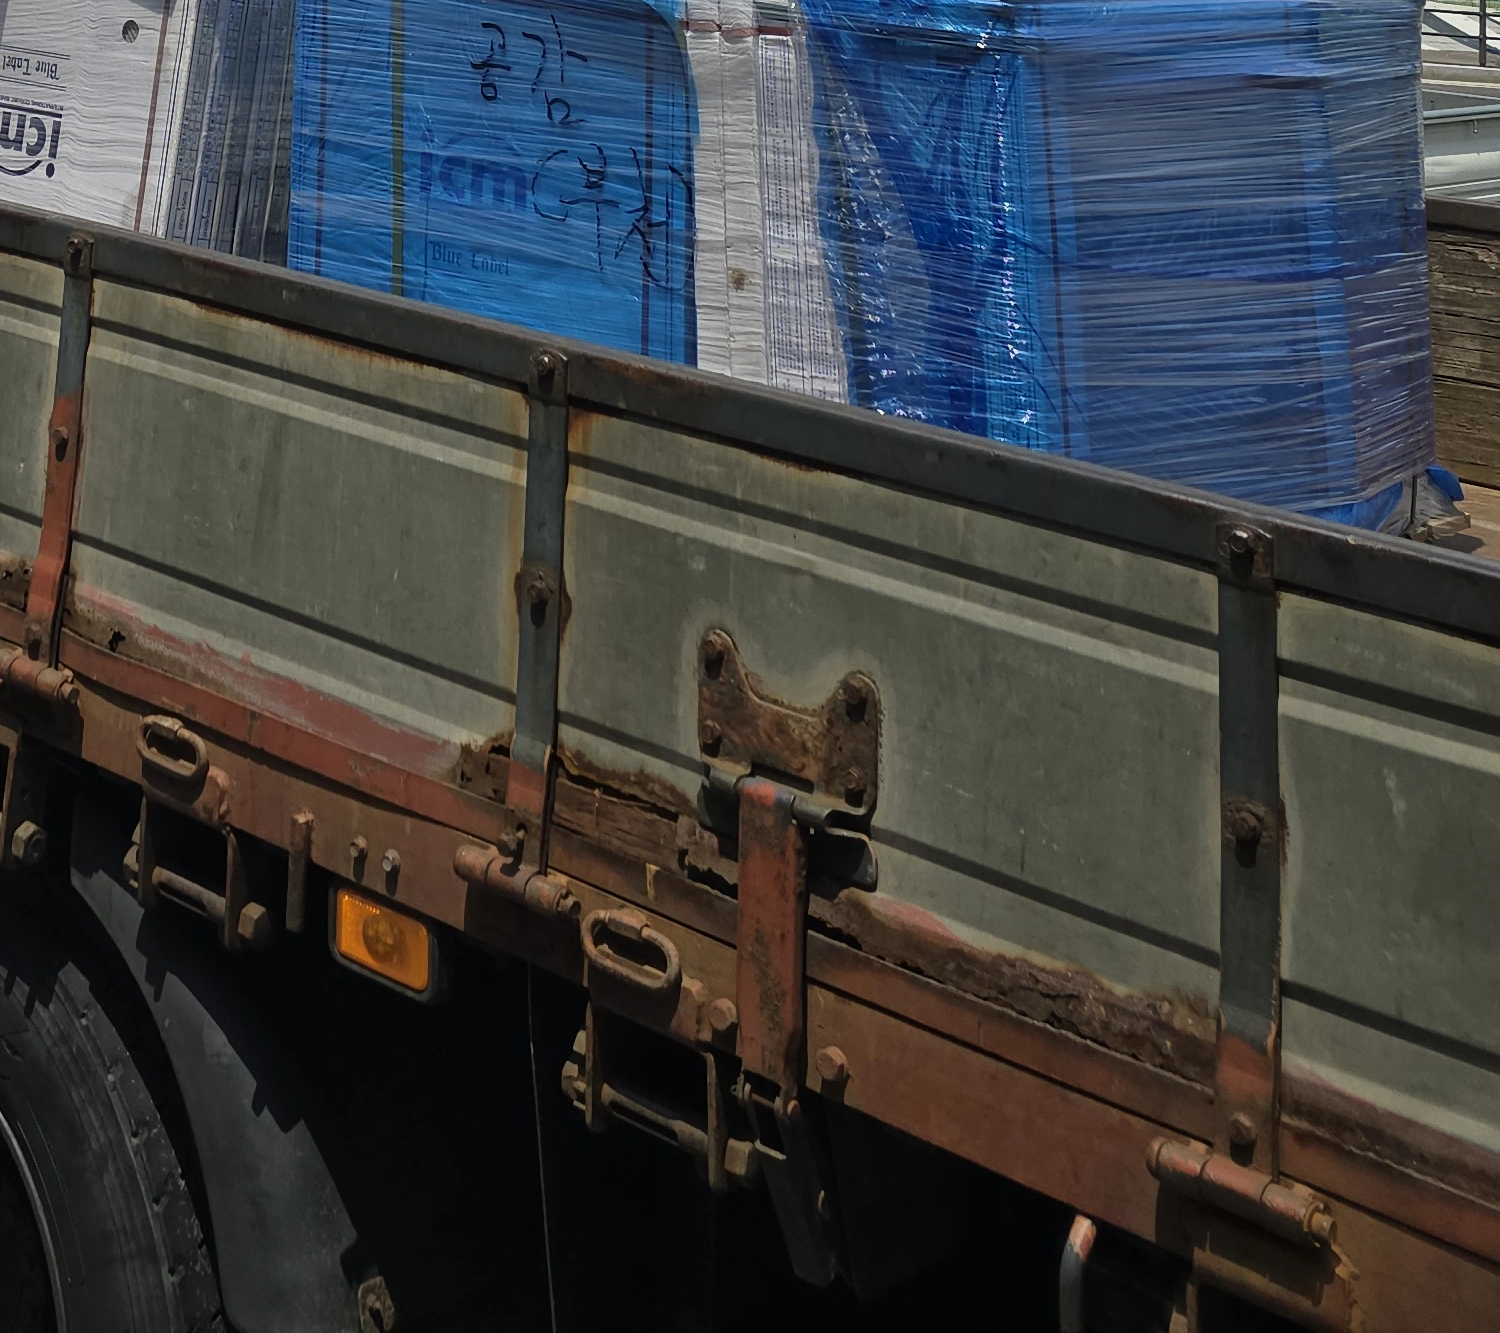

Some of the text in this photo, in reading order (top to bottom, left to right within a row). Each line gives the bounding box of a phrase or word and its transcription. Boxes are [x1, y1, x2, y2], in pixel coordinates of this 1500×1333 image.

[2, 54, 60, 81] Blue Label
[430, 240, 462, 267] Blue
